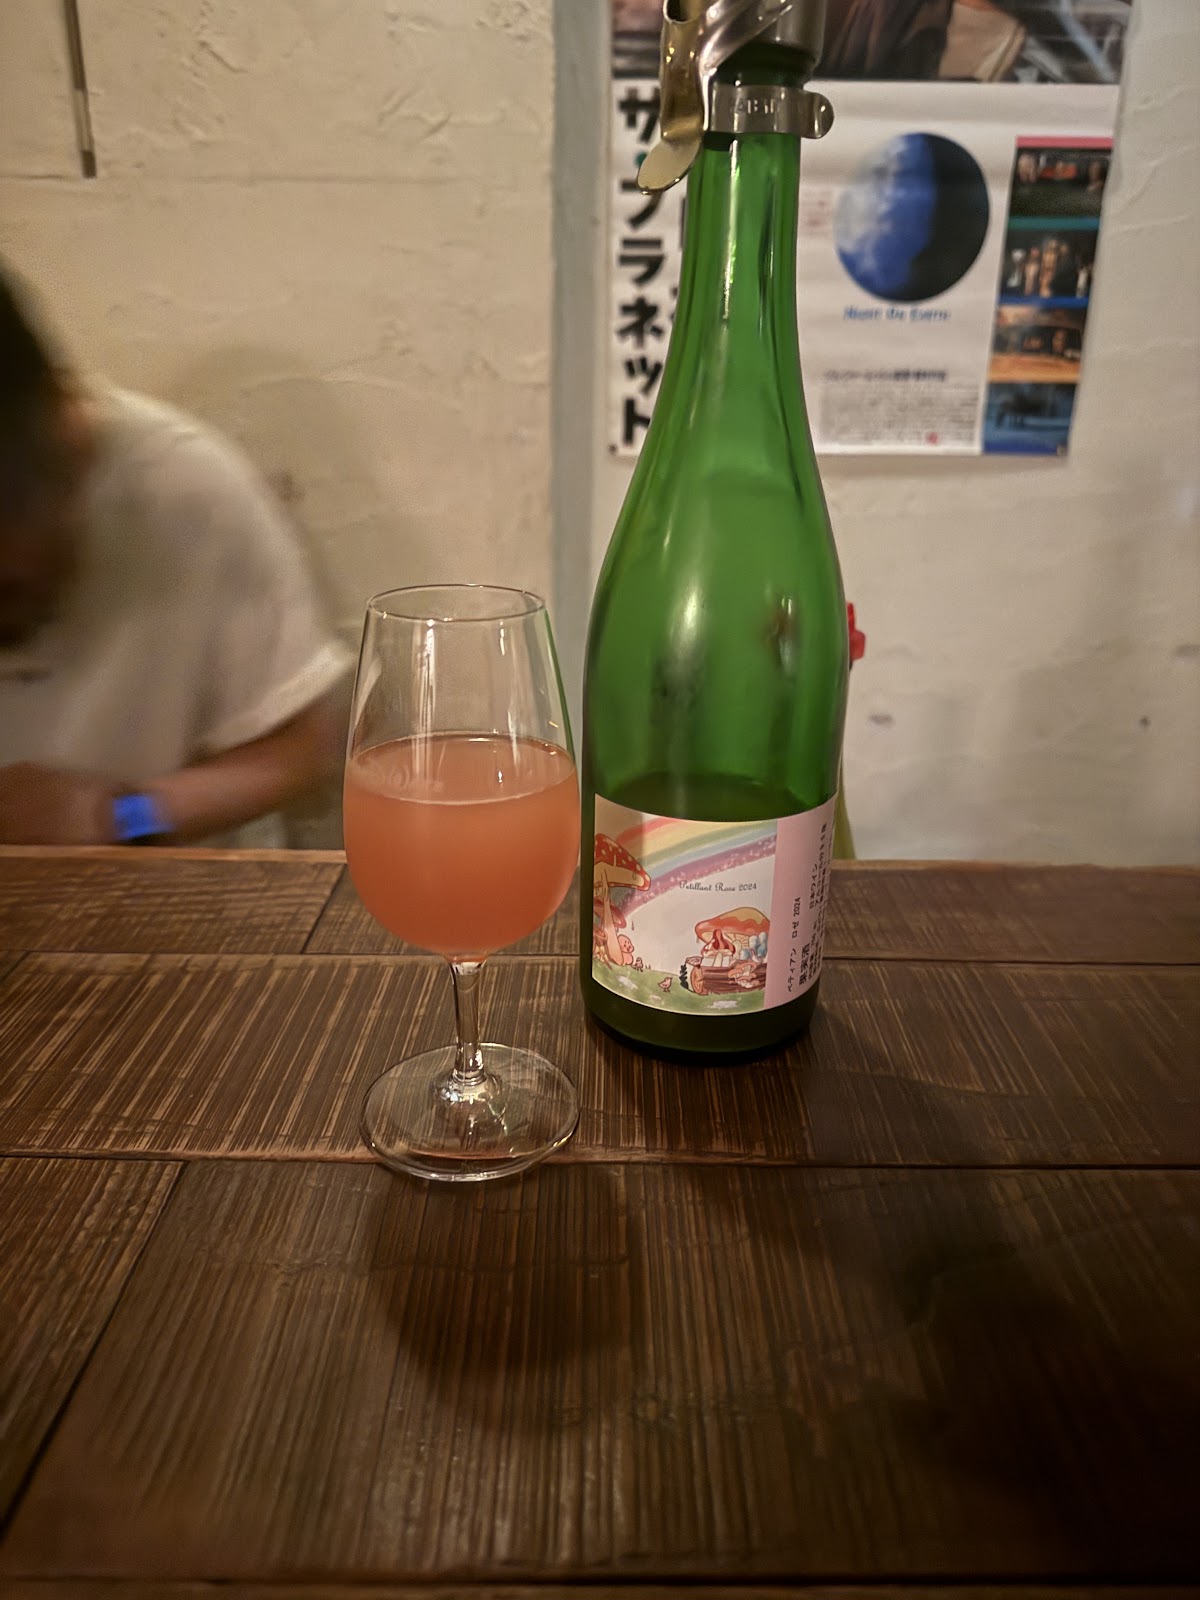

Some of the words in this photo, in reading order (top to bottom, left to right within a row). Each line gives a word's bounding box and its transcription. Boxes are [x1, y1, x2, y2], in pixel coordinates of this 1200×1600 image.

[738, 882, 757, 892] 2024
[809, 863, 818, 909] 日本ワイン
[793, 896, 802, 917] 2024
